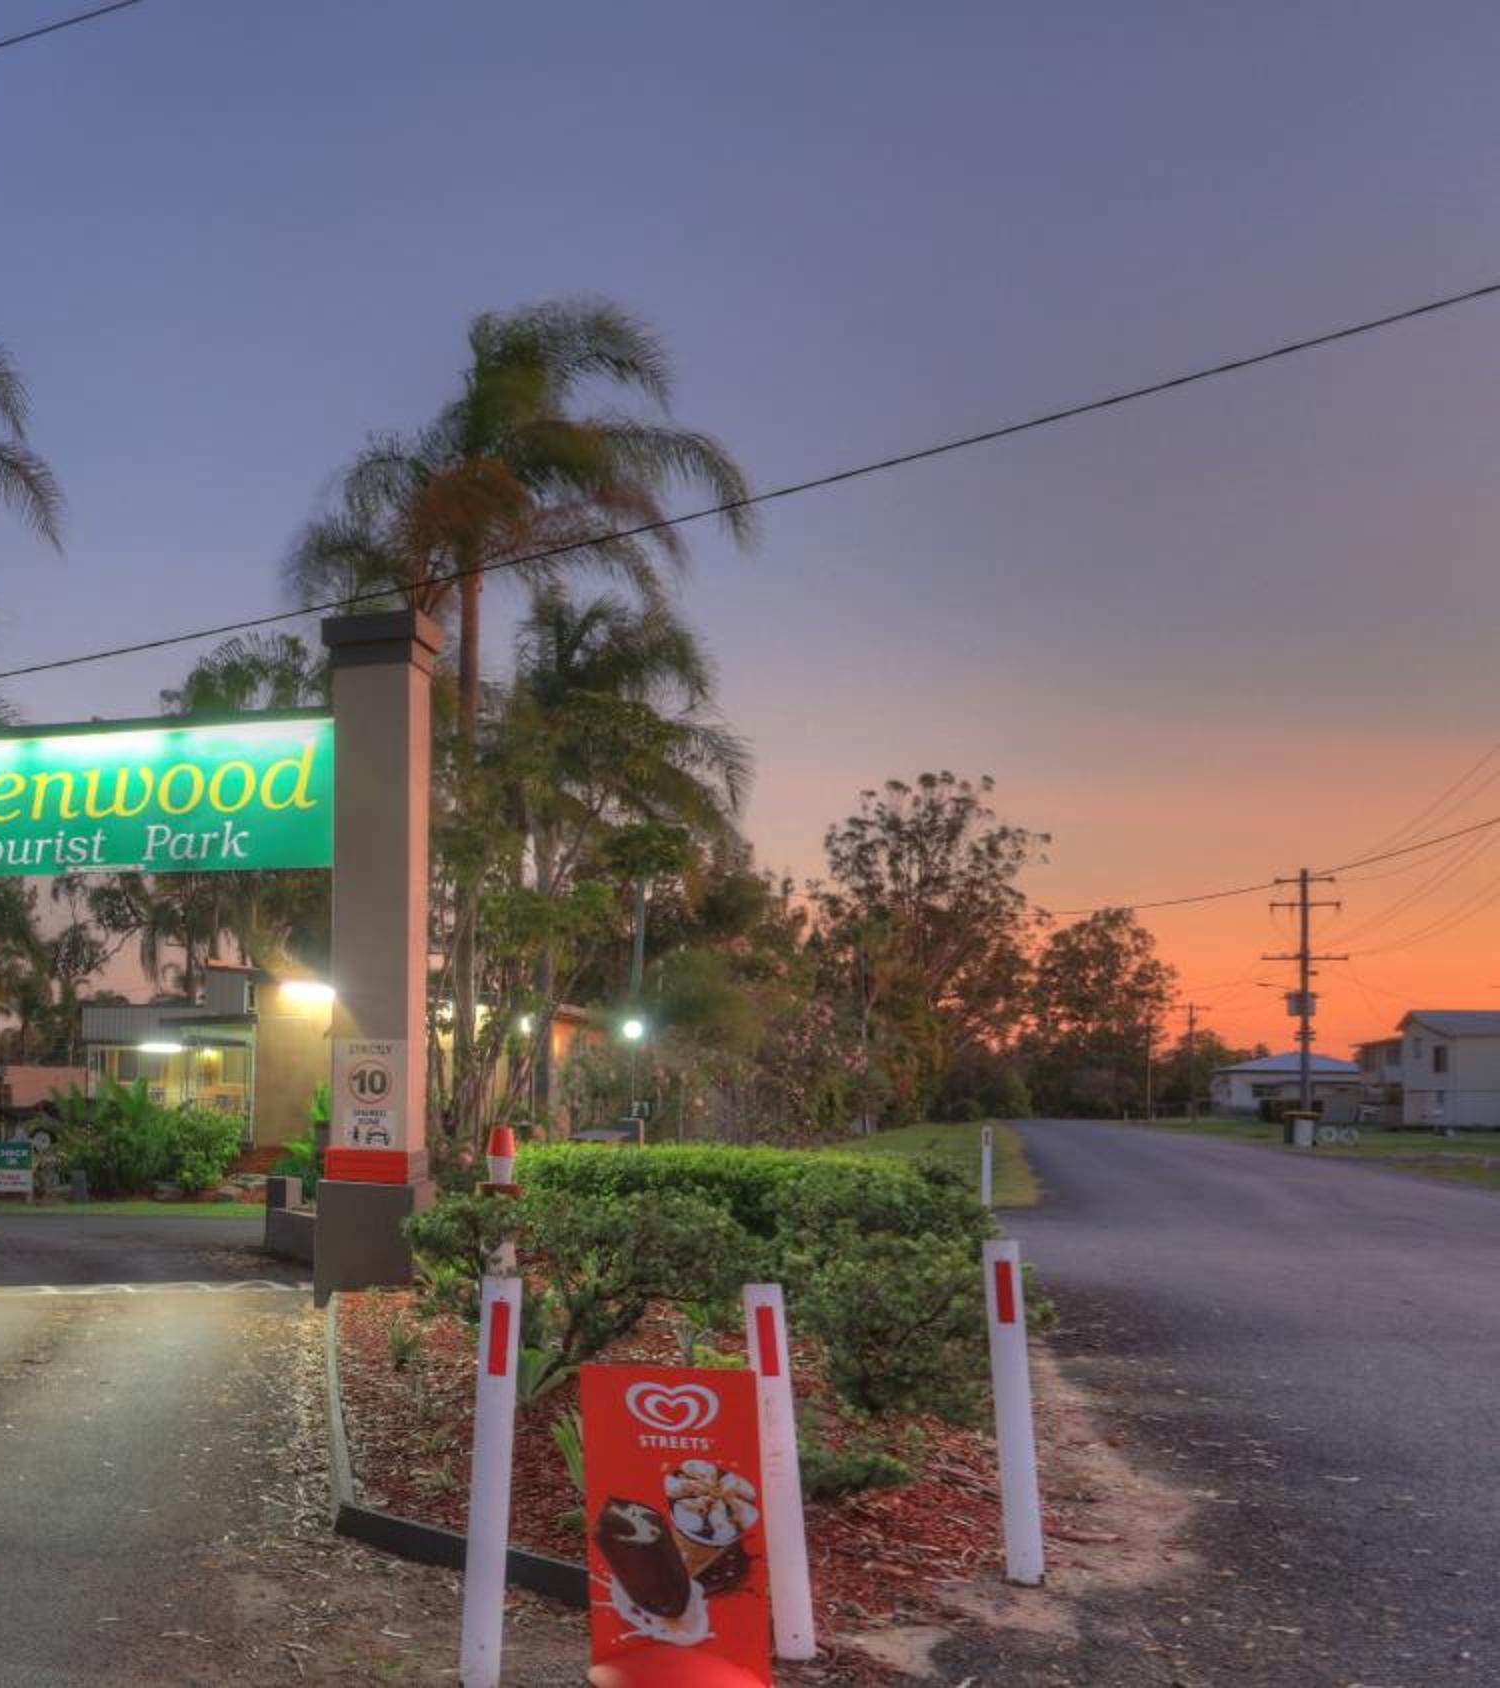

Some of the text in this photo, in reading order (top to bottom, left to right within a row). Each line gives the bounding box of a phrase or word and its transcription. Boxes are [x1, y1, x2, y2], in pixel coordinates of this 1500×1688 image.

[143, 820, 251, 862] Park
[353, 1069, 387, 1095] 10
[638, 1433, 709, 1451] STREETS
